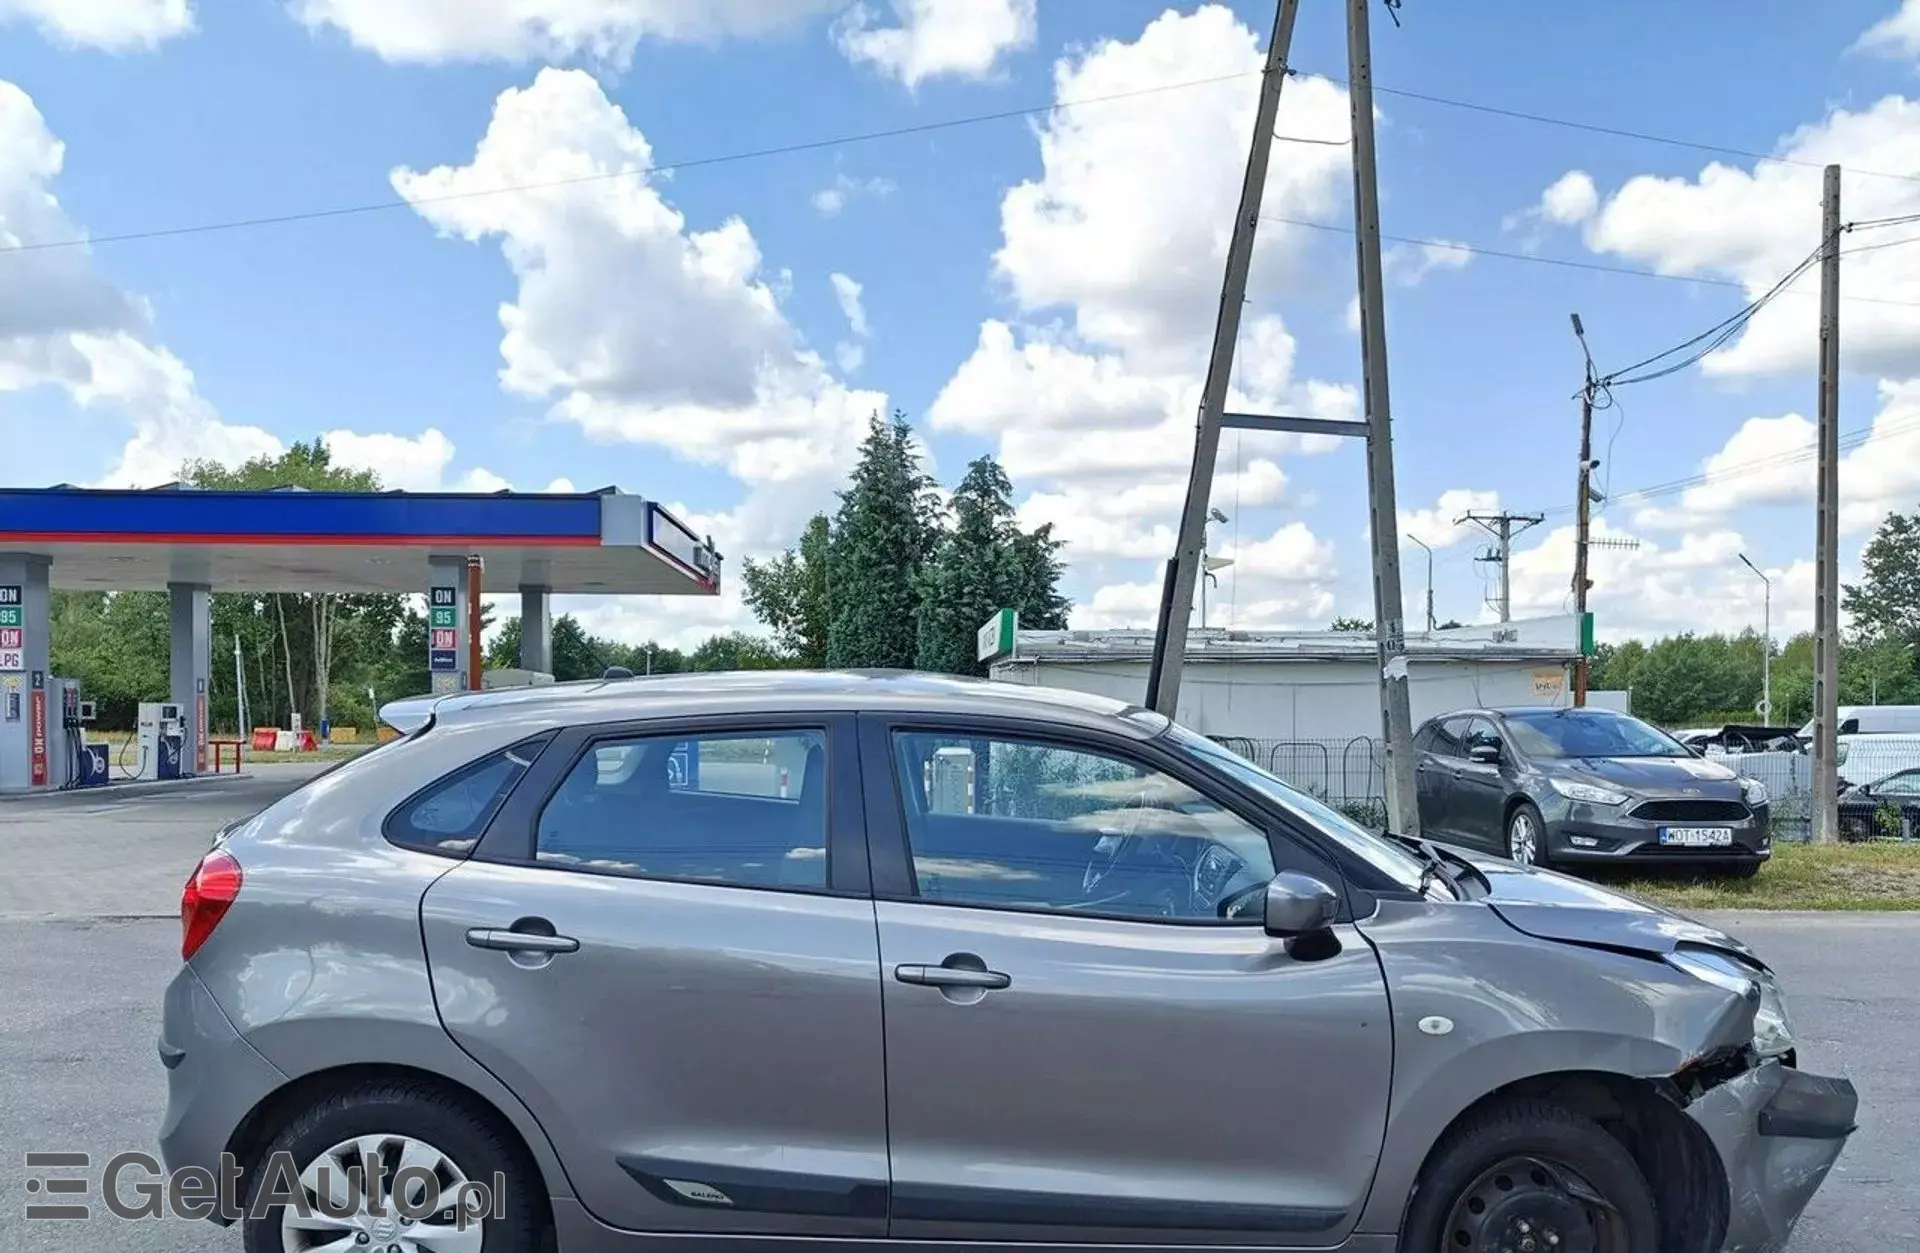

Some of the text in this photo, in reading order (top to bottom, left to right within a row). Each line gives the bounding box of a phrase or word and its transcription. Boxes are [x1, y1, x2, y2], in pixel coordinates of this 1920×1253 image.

[0, 588, 17, 603] ON
[435, 589, 451, 603] ON
[436, 611, 451, 624] 95
[1, 629, 19, 645] ON
[436, 632, 453, 647] ON
